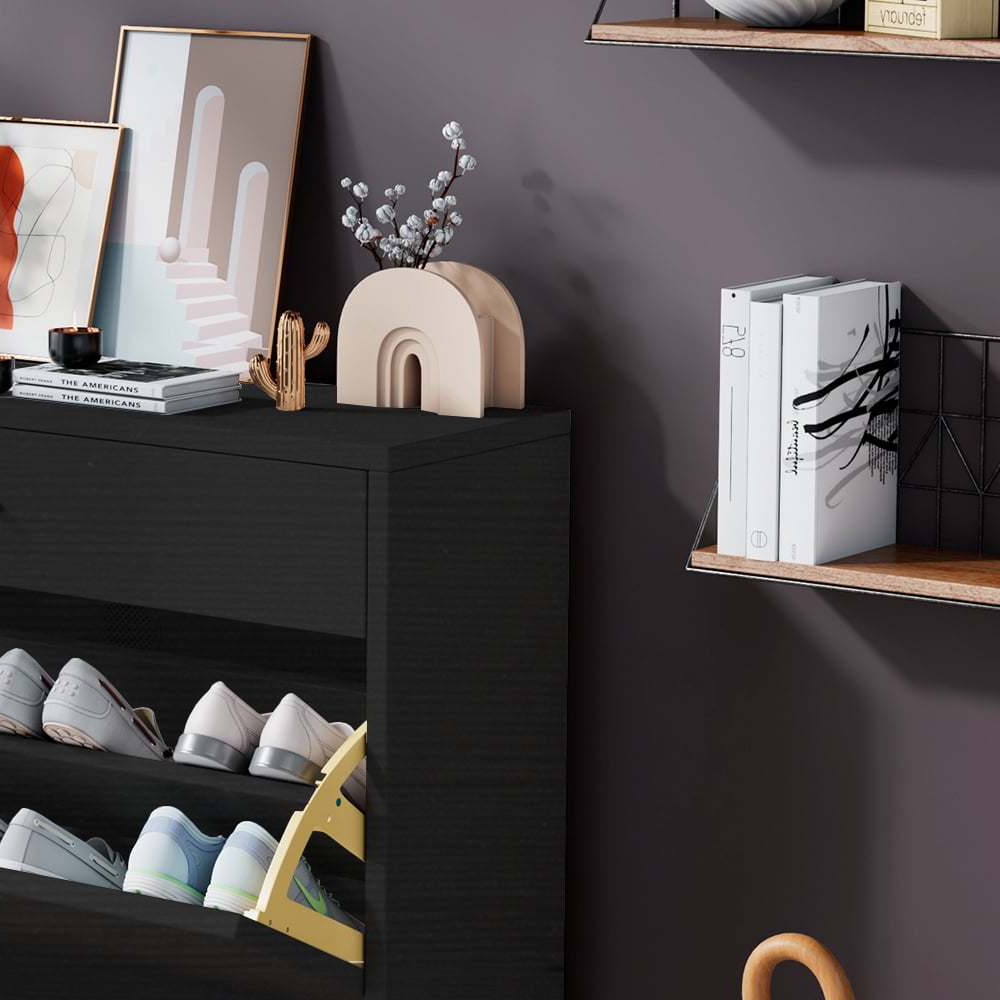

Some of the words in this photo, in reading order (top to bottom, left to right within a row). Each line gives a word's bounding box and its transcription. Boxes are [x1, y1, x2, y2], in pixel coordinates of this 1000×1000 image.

[61, 379, 79, 387] THE
[82, 381, 139, 394] AMERICANS
[62, 394, 80, 402] THE
[83, 396, 141, 409] AMERICANS
